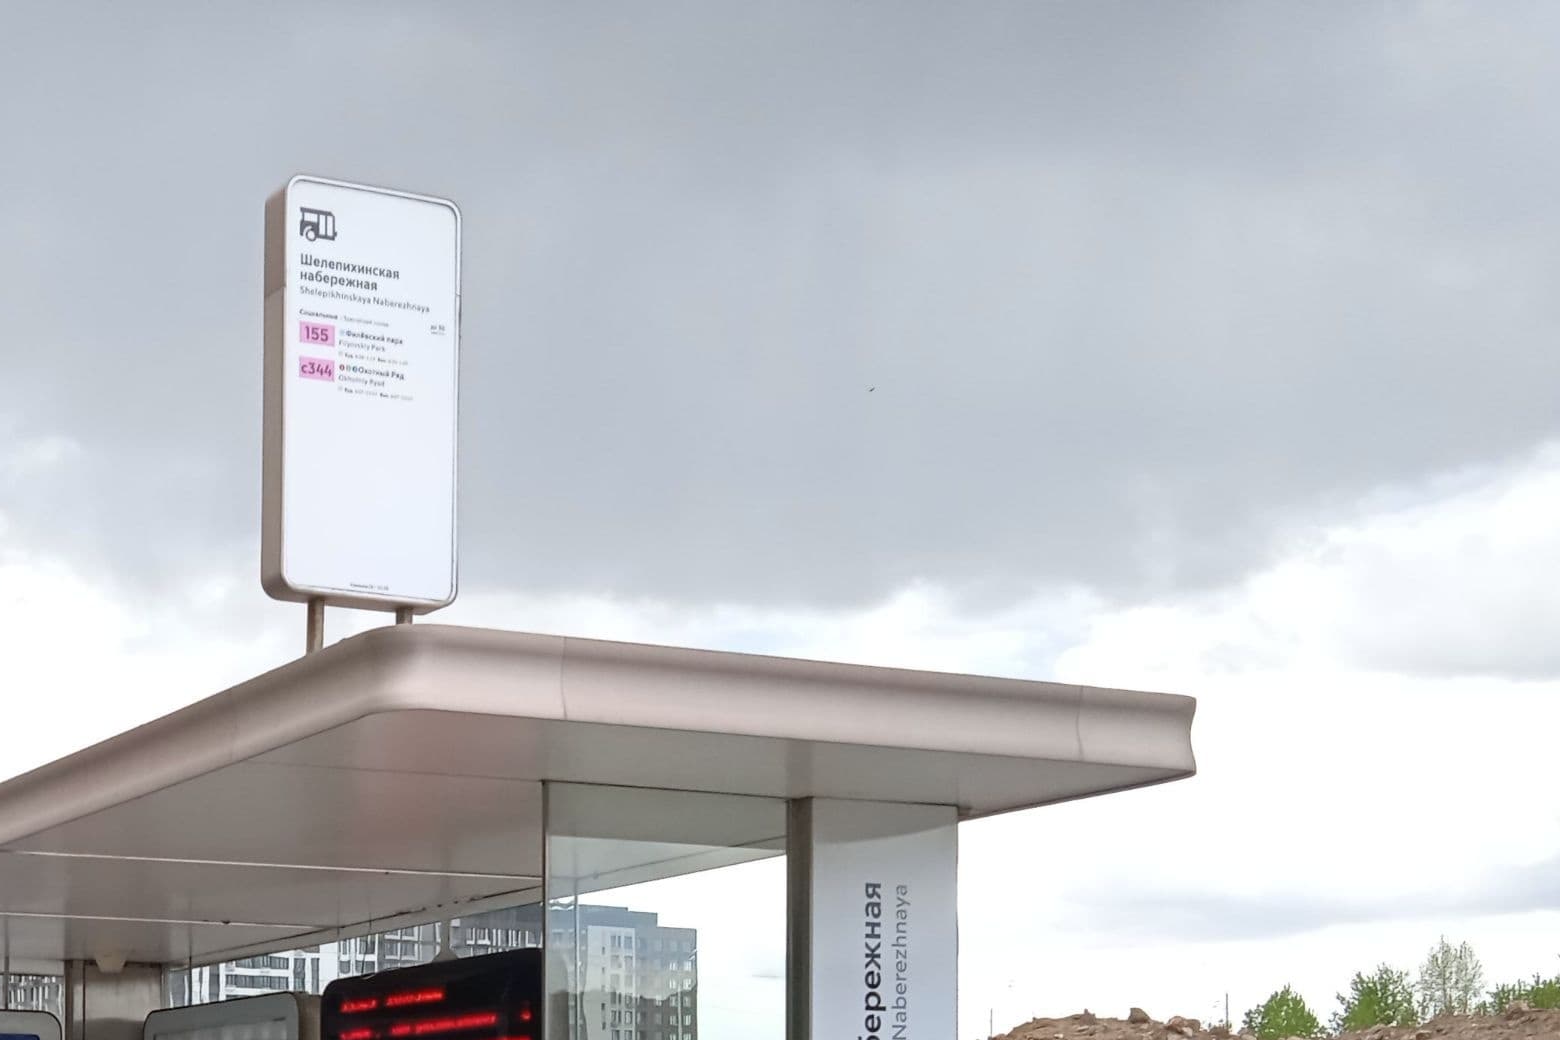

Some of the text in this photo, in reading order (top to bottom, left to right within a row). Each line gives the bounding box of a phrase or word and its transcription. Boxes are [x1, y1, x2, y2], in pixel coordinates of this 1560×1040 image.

[300, 253, 400, 280] Шелепихинская
[300, 271, 378, 292] набережная
[300, 286, 430, 313] Shelepikhinskaya Naberezhnaya
[304, 325, 329, 342] 155
[891, 884, 911, 1040] Naberezhnaya
